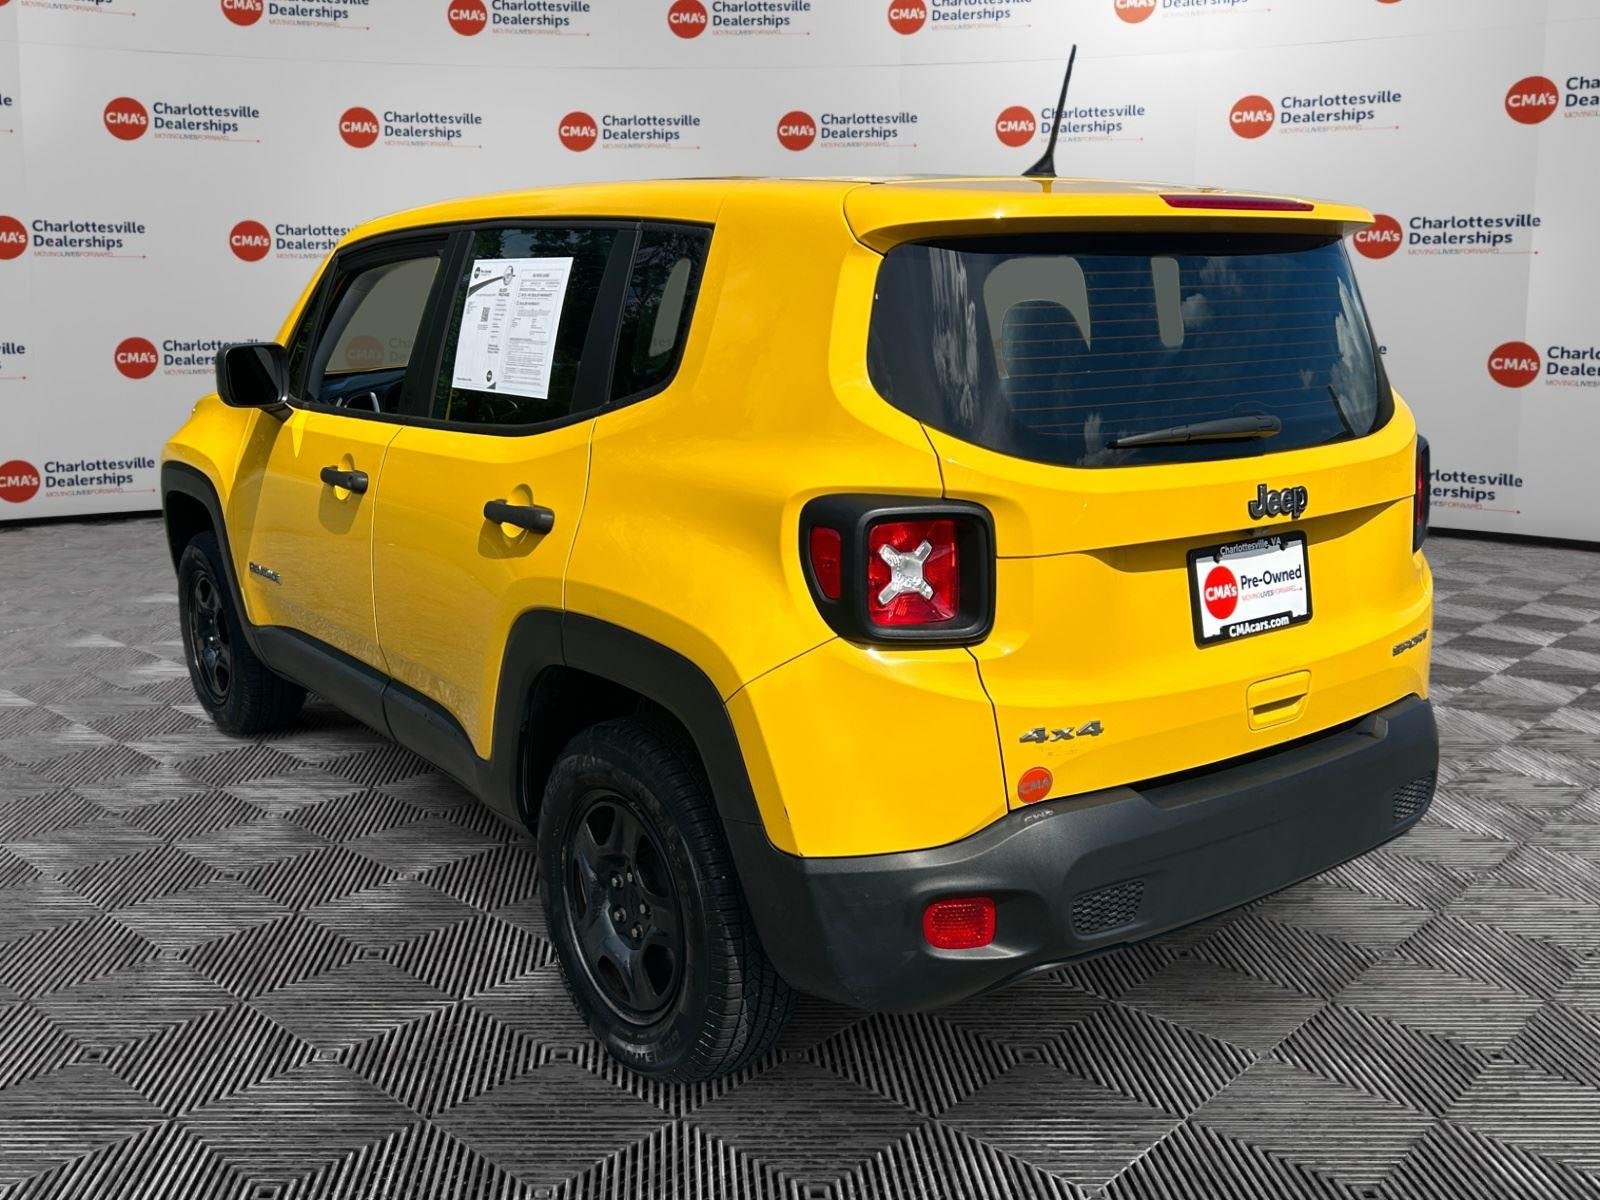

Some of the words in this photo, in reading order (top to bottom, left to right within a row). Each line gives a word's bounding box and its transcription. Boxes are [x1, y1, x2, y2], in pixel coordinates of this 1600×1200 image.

[269, 3, 349, 20] Dealerships
[492, 0, 590, 12] Charlottesville
[712, 0, 811, 12] Charlottesville
[450, 9, 486, 21] CMA's
[492, 13, 570, 28] Dealerships
[669, 13, 706, 24] CMA's
[890, 9, 925, 20] CMA's
[932, 8, 1011, 21] Dealerships
[712, 15, 790, 28] Dealerships
[1281, 90, 1402, 108] Charlottesville
[1508, 93, 1557, 108] CMA's
[153, 102, 260, 118] Charlottesville
[1231, 110, 1273, 123] CMA's
[105, 112, 147, 125] CMA's
[384, 111, 482, 125] Charlottesville
[602, 115, 701, 127] Charlottesville
[821, 113, 918, 125] Charlottesville
[1280, 110, 1375, 125] Dealerships
[154, 117, 239, 134] Dealerships
[341, 121, 378, 134] CMA's
[560, 125, 596, 138] CMA's
[779, 125, 816, 137] CMA's
[998, 120, 1034, 132] CMA's
[1041, 120, 1122, 134] Dalerships
[384, 126, 462, 140] Dealerships
[603, 129, 680, 143] Dealerships
[821, 127, 898, 140] Dealerships
[32, 219, 145, 234] Charlottesville
[1409, 214, 1541, 229] Charlottesville
[275, 224, 350, 236] Charlottes
[1355, 230, 1400, 243] CMA's
[0, 231, 26, 244] MA's
[33, 235, 123, 250] Dealerships
[231, 235, 270, 246] CMA's
[1409, 231, 1513, 246] Dealerships
[276, 239, 336, 250] Dealersh
[117, 352, 156, 364] CMA's
[1490, 357, 1538, 371] CMA's
[44, 457, 155, 473] Charlottesville
[0, 475, 39, 487] CMA's
[45, 473, 133, 488] Dealerships
[1248, 483, 1308, 521] Jeep
[1271, 536, 1281, 546] VA
[1240, 564, 1302, 590] Pre-Owned
[1205, 583, 1237, 602] CMA's
[1229, 616, 1289, 637] CMAcars.com
[1019, 720, 1104, 743] 4x4
